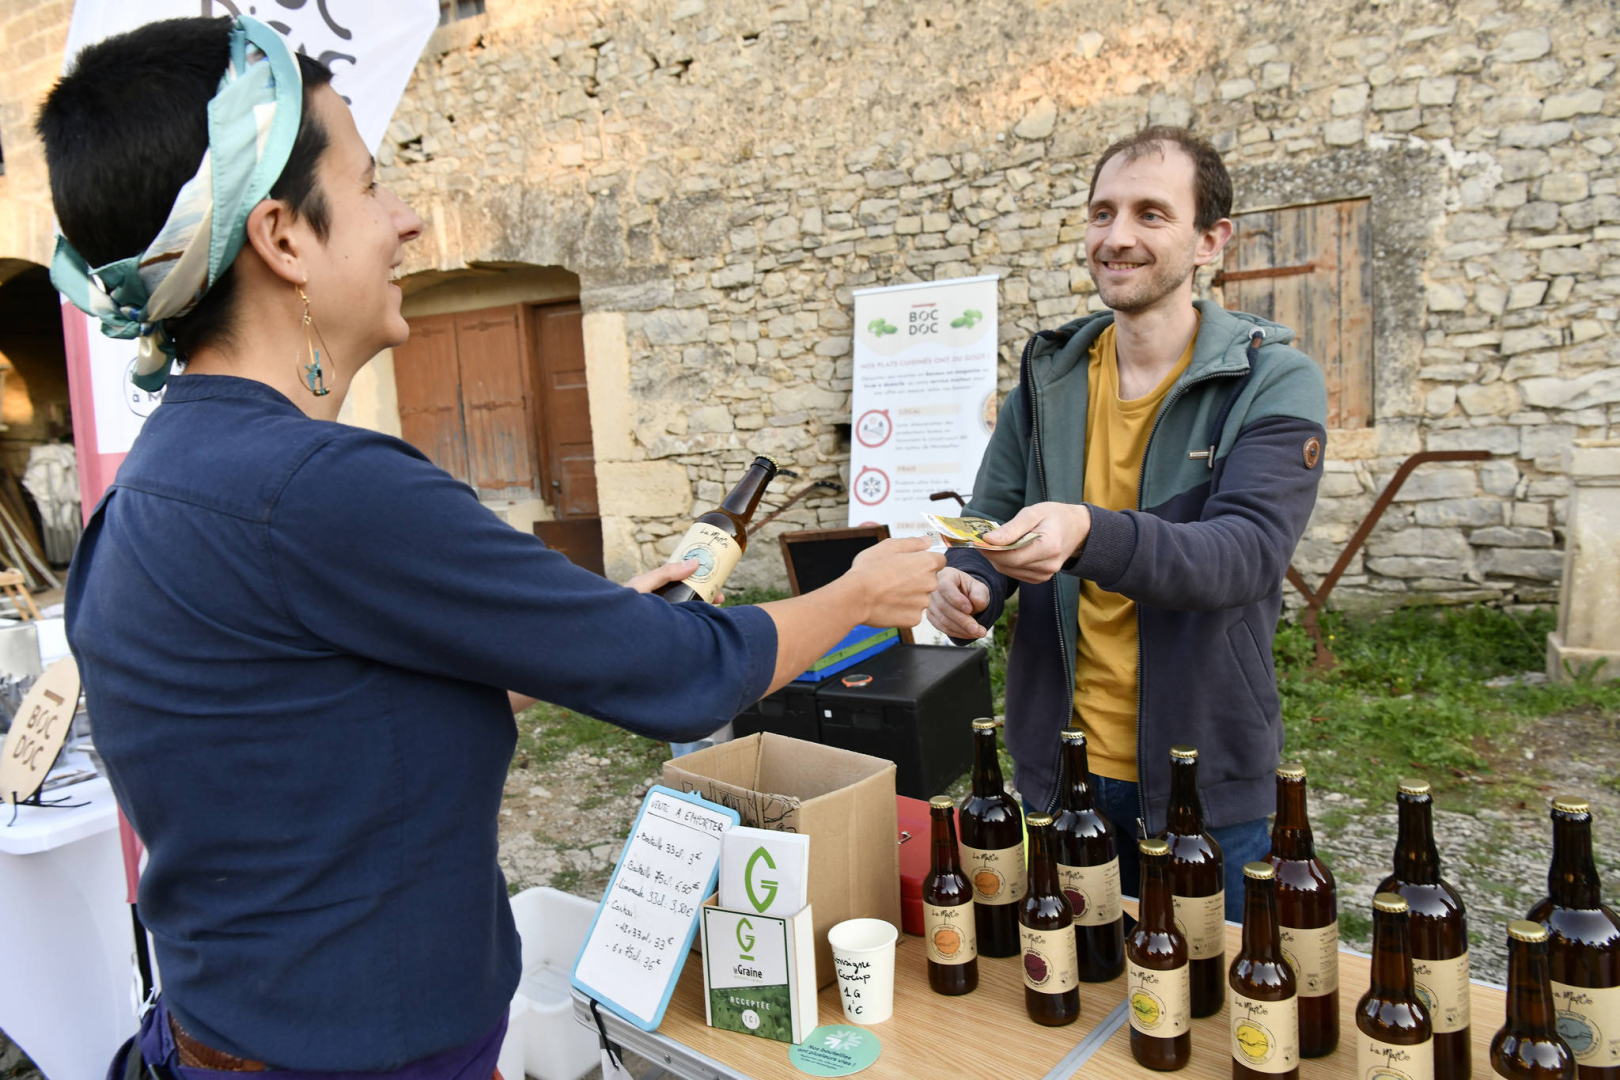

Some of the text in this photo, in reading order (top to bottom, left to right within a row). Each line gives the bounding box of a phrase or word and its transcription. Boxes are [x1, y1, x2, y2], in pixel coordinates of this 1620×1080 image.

[909, 309, 939, 322] BOC
[909, 322, 939, 335] DOC
[877, 360, 898, 368] PLATS
[898, 408, 921, 416] LOCAL
[26, 704, 58, 740] BOC
[13, 734, 44, 771] DOC
[651, 799, 724, 832] VENTE A EMPORTER
[737, 964, 763, 979] Graine
[843, 986, 861, 999] 1 G
[729, 996, 770, 1011] ACCEPTÉE
[847, 1004, 852, 1013] 1
[743, 1013, 758, 1025] ICI
[1369, 1043, 1381, 1055] La
